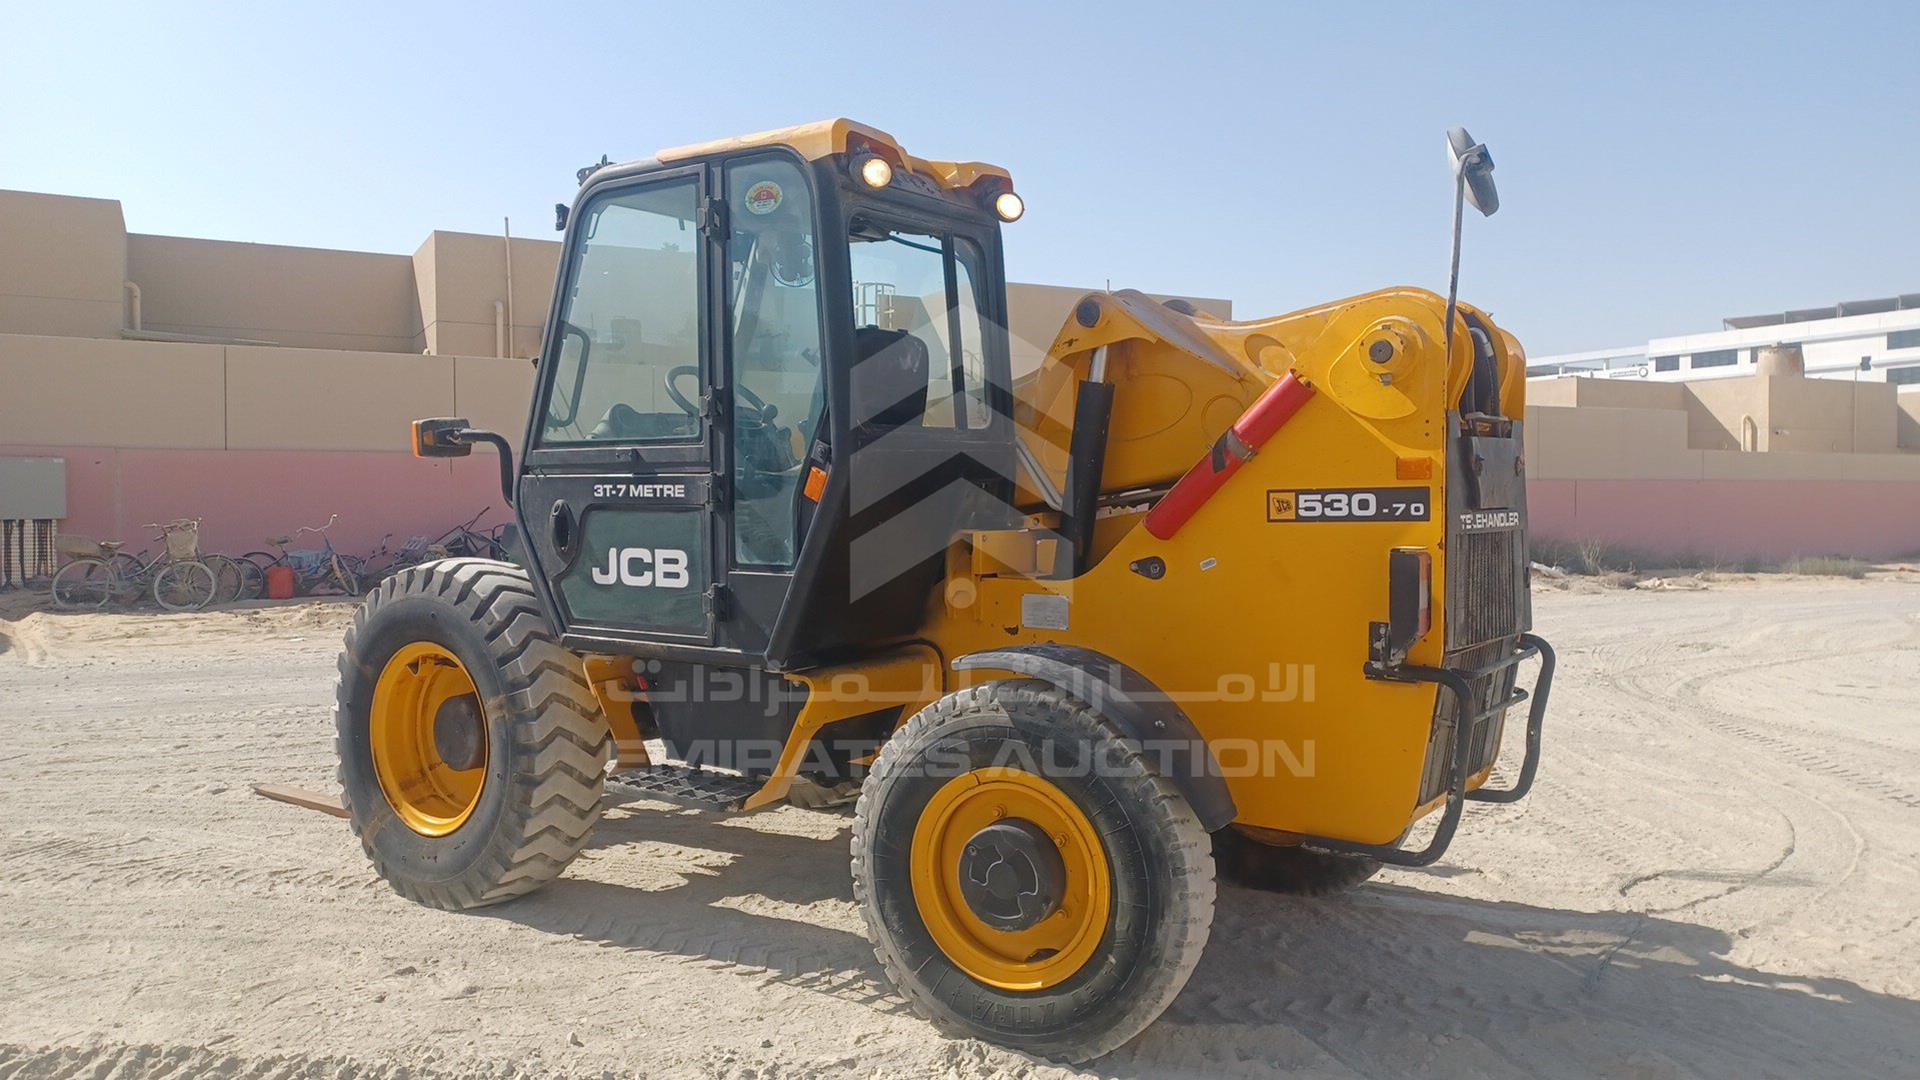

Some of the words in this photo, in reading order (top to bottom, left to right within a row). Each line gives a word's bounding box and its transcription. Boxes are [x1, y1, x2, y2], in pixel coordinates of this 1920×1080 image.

[593, 484, 627, 498] 3T-7
[629, 484, 685, 498] METRE
[592, 547, 689, 589] JCB
